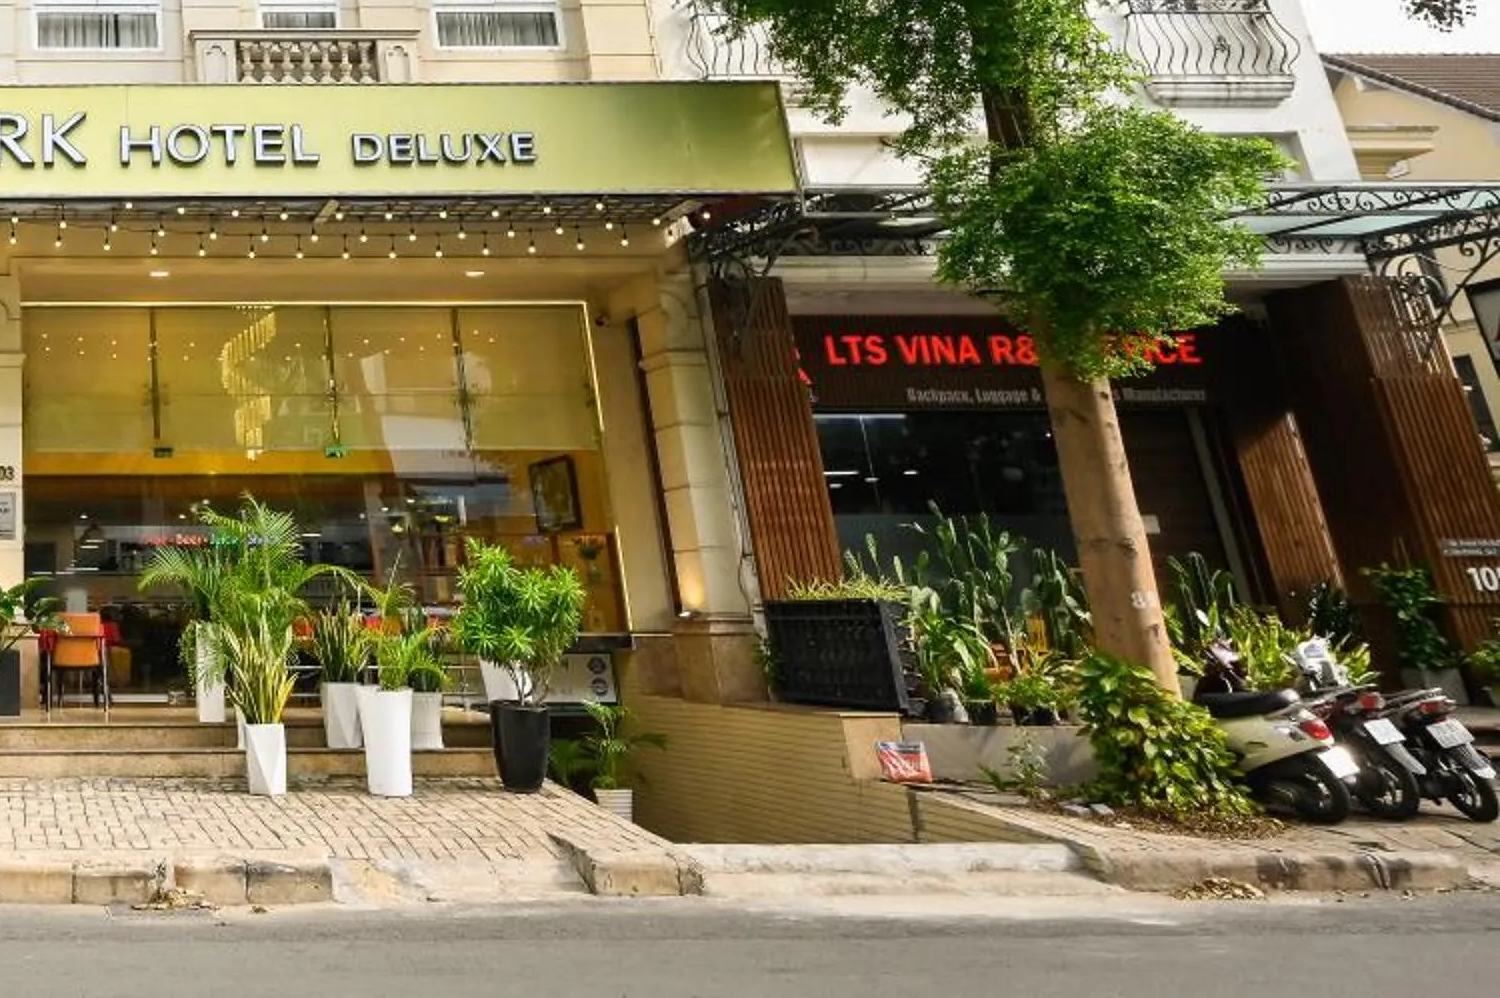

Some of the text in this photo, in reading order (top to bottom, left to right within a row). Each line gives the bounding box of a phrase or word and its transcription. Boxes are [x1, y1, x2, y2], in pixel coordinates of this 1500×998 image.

[119, 123, 321, 165] HOTEL
[351, 131, 538, 164] DELUXE
[824, 334, 888, 365] LTS
[894, 334, 982, 365] VINA
[988, 334, 1038, 366] R&
